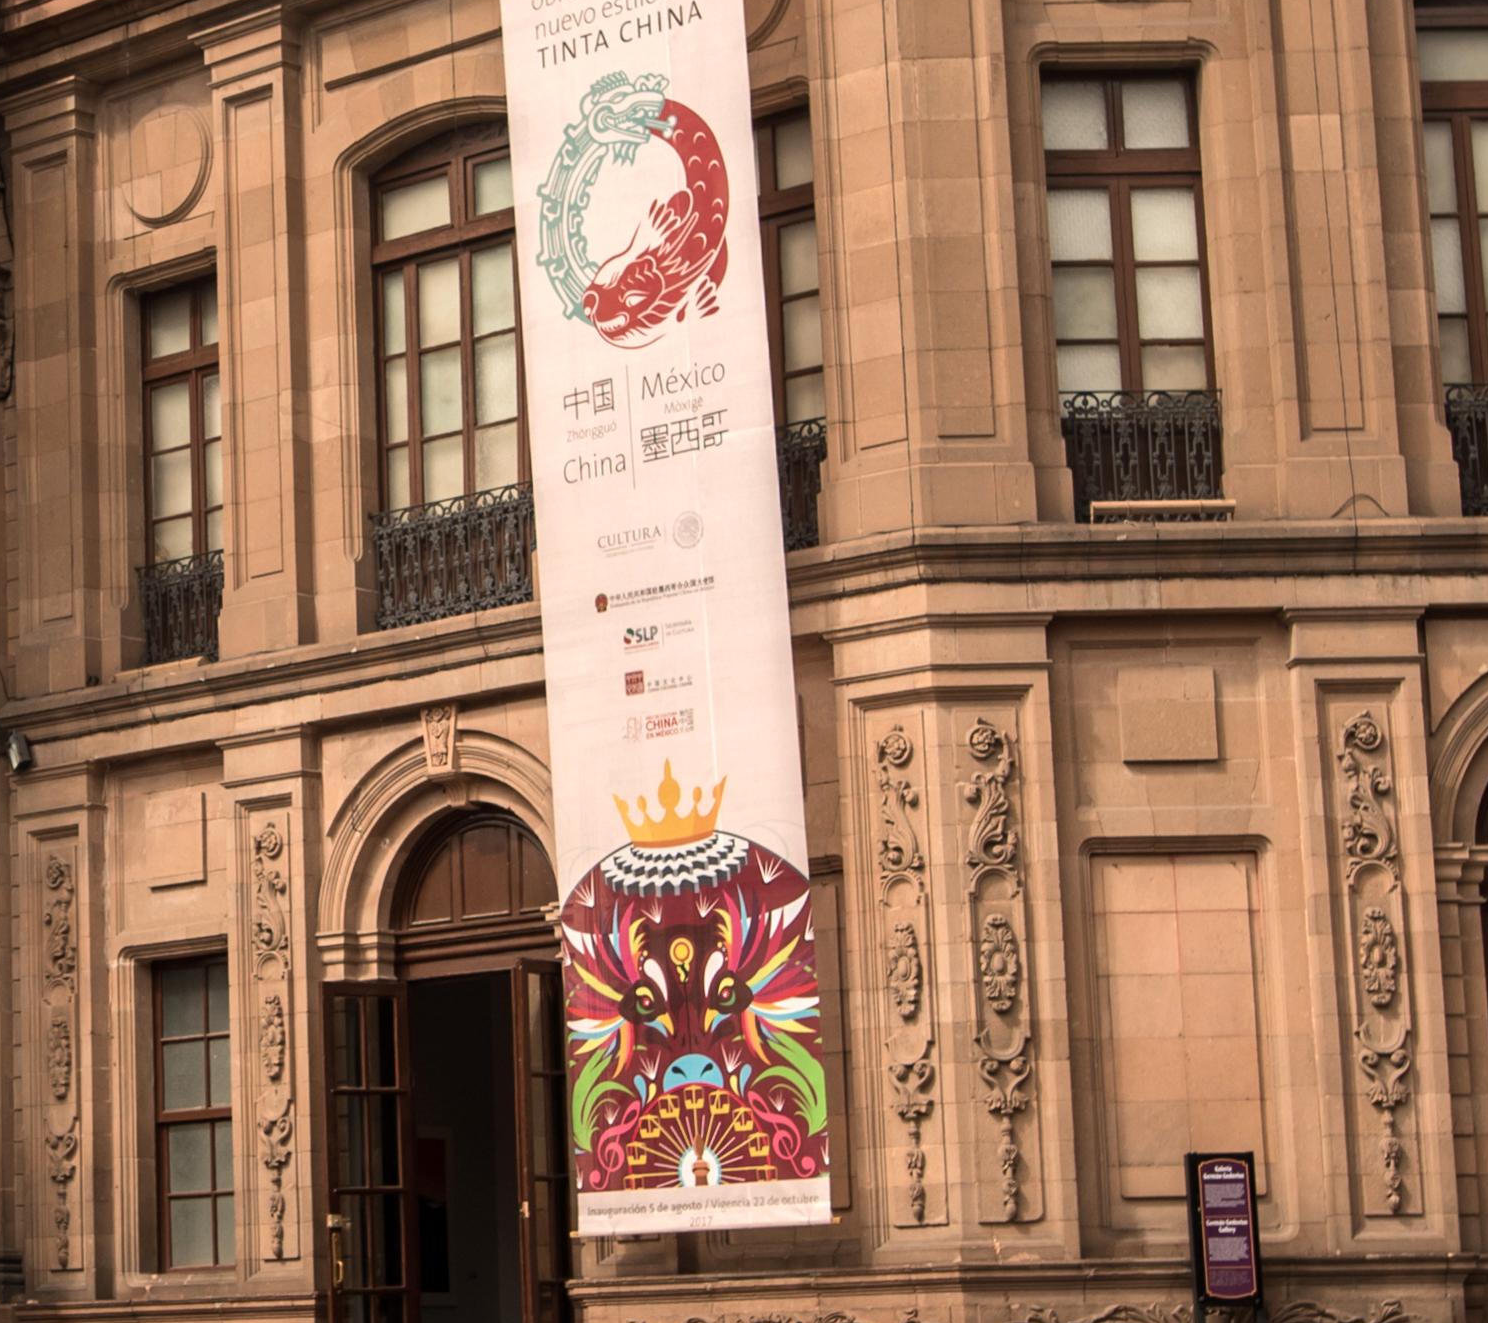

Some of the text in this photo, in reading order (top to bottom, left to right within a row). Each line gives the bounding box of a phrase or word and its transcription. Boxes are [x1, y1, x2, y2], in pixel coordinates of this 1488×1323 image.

[534, 6, 596, 40] nuevo
[537, 0, 703, 69] TINTA CHINA
[641, 362, 726, 400] México
[563, 378, 615, 420] 中国
[640, 409, 729, 463] 墨西哥
[563, 453, 627, 484] China
[597, 525, 662, 549] CULTURA
[635, 625, 658, 643] SLP
[645, 716, 678, 732] CHINA
[587, 1200, 647, 1218] Inauguración
[649, 1202, 656, 1213] 5
[657, 1200, 670, 1212] de
[671, 1199, 703, 1215] agosto
[753, 1196, 766, 1208] 22
[767, 1194, 780, 1206] de
[781, 1193, 819, 1205] octubre
[689, 1215, 713, 1227] 2017
